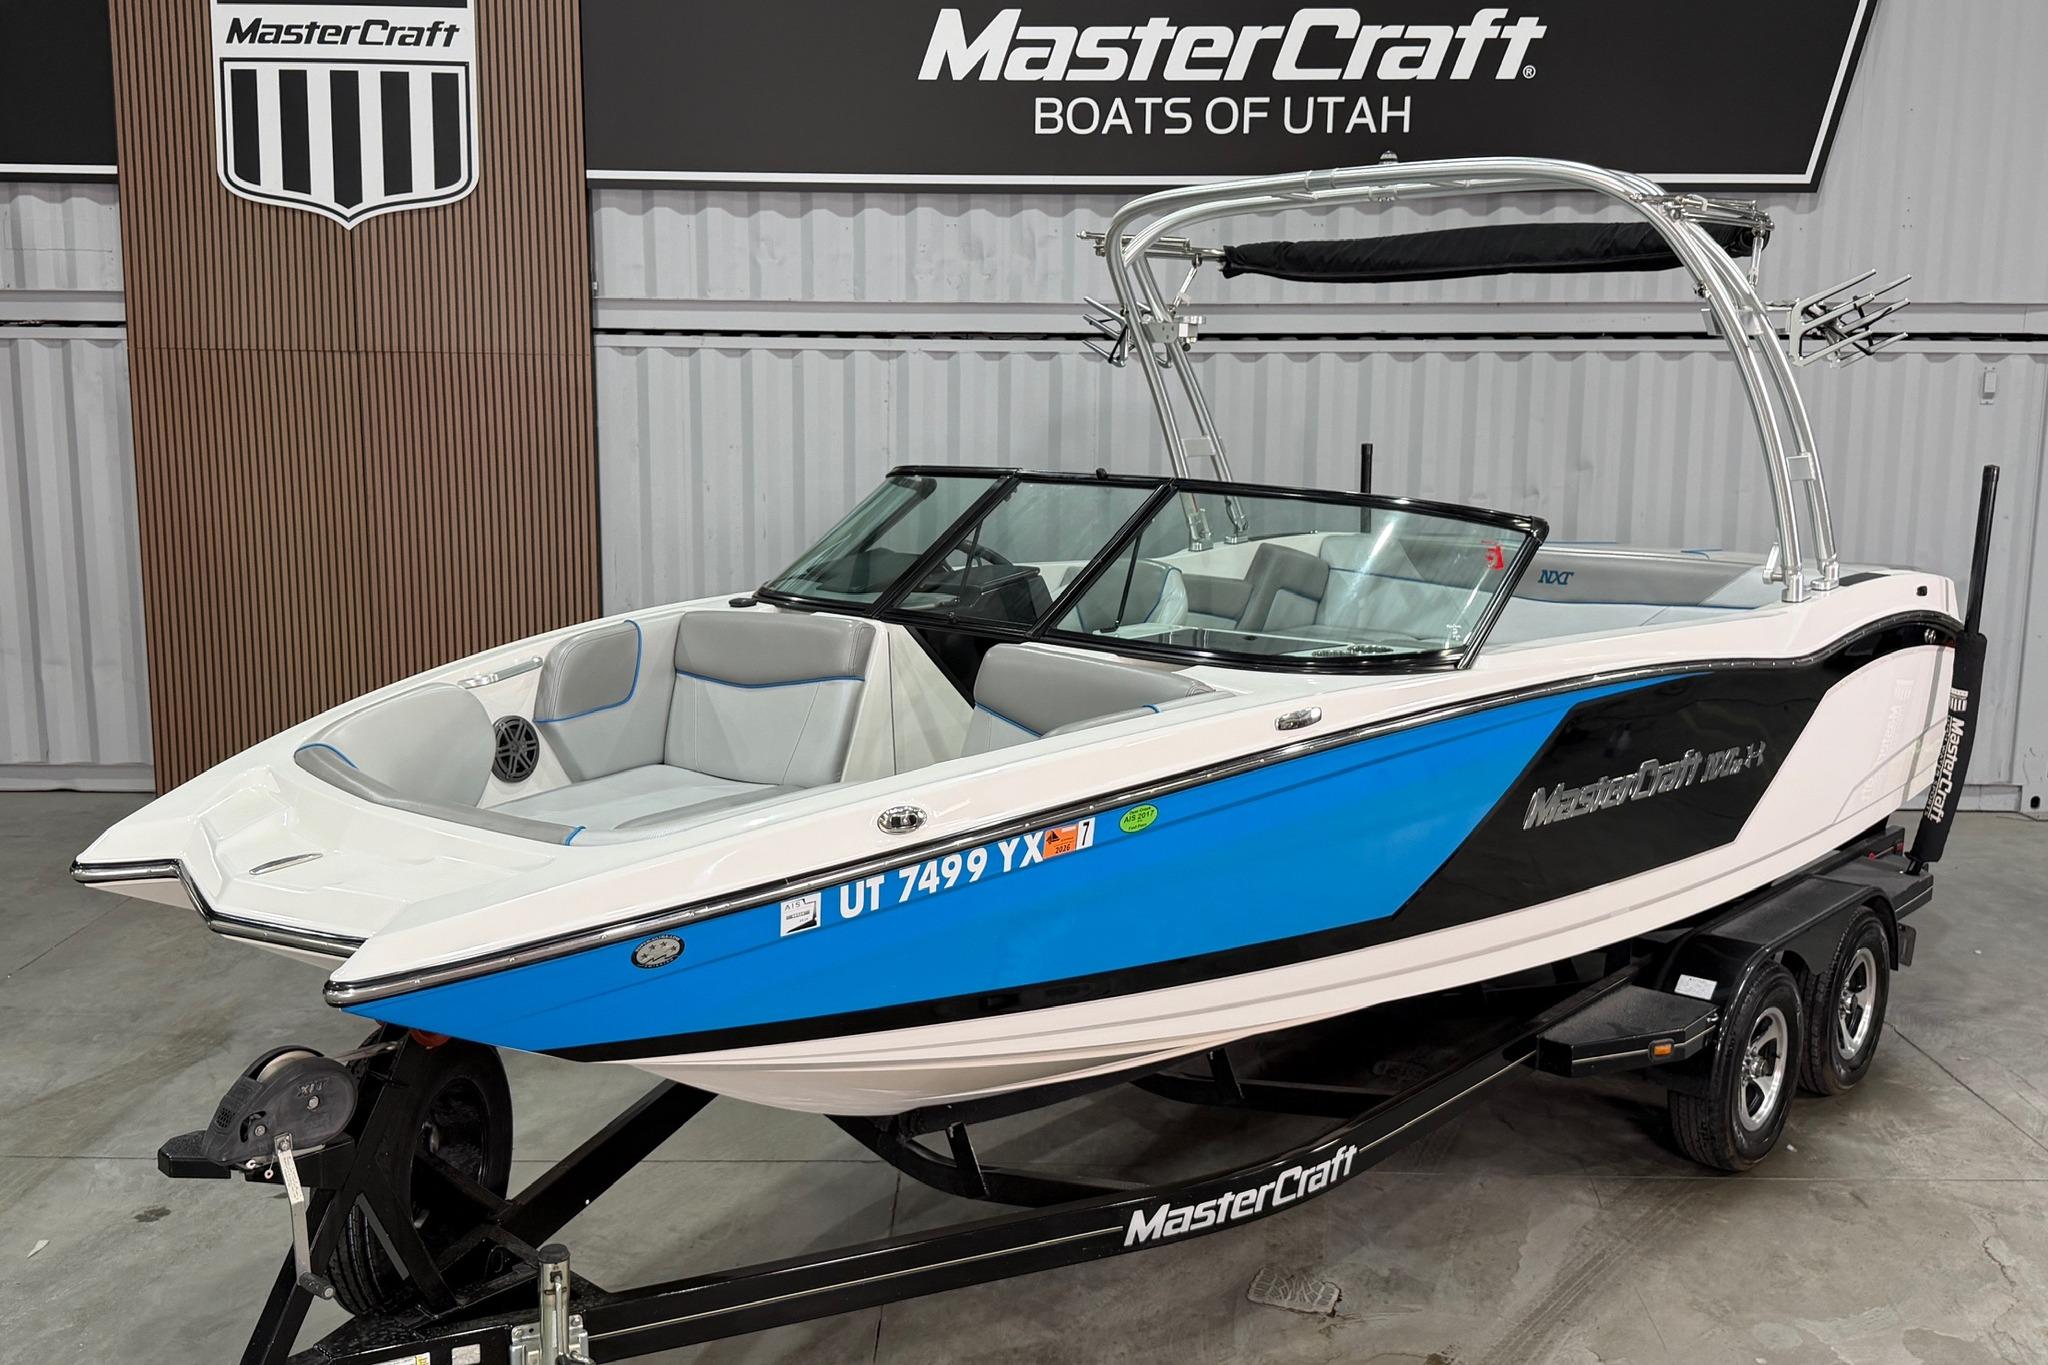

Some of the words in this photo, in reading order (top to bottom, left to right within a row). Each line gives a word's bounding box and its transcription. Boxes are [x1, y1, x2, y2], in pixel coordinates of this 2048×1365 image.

[226, 17, 460, 48] MasterCraft
[1034, 97, 1192, 135] BOATS
[1204, 97, 1269, 134] OF
[1283, 96, 1411, 134] UTAH
[1538, 569, 1574, 585] NXT
[1929, 716, 1965, 823] MasterCraft
[1523, 748, 1703, 830] MasterCraft
[1123, 814, 1136, 823] AIS
[1137, 809, 1155, 820] 2017
[1055, 843, 1071, 854] 2026
[1082, 821, 1090, 846] 7
[840, 874, 885, 919] UT
[899, 848, 988, 903] 7499
[998, 831, 1044, 873] YX
[784, 901, 801, 911] AIS
[1123, 1144, 1358, 1247] MasterCraft
